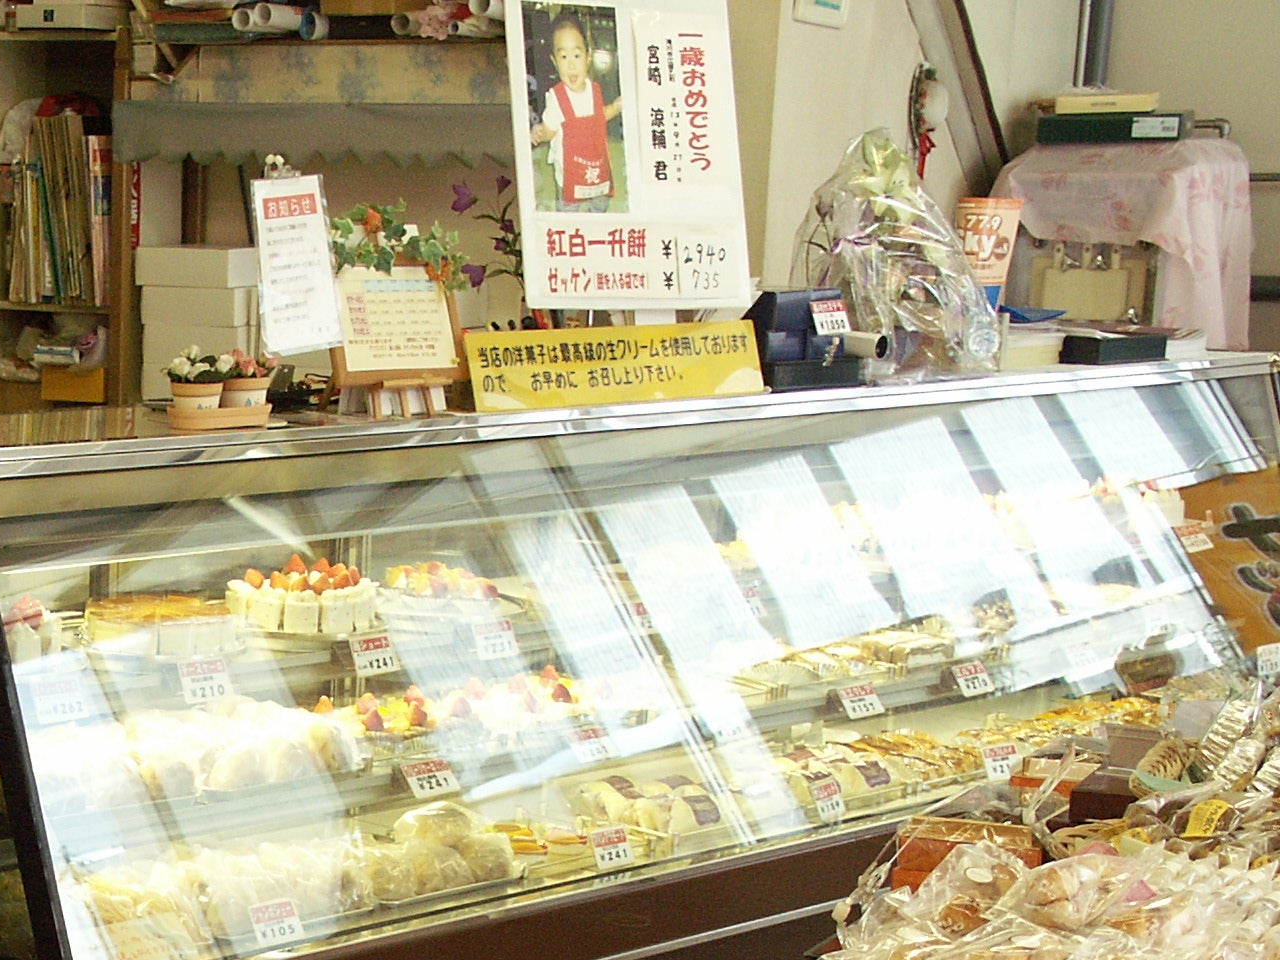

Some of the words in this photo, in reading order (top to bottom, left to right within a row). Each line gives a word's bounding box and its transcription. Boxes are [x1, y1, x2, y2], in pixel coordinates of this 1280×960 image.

[266, 196, 313, 219] お知らせ
[547, 228, 646, 258] 紅白一升餅
[530, 370, 579, 392] お早めに
[191, 683, 226, 699] ¥210
[260, 923, 296, 940] ¥105
